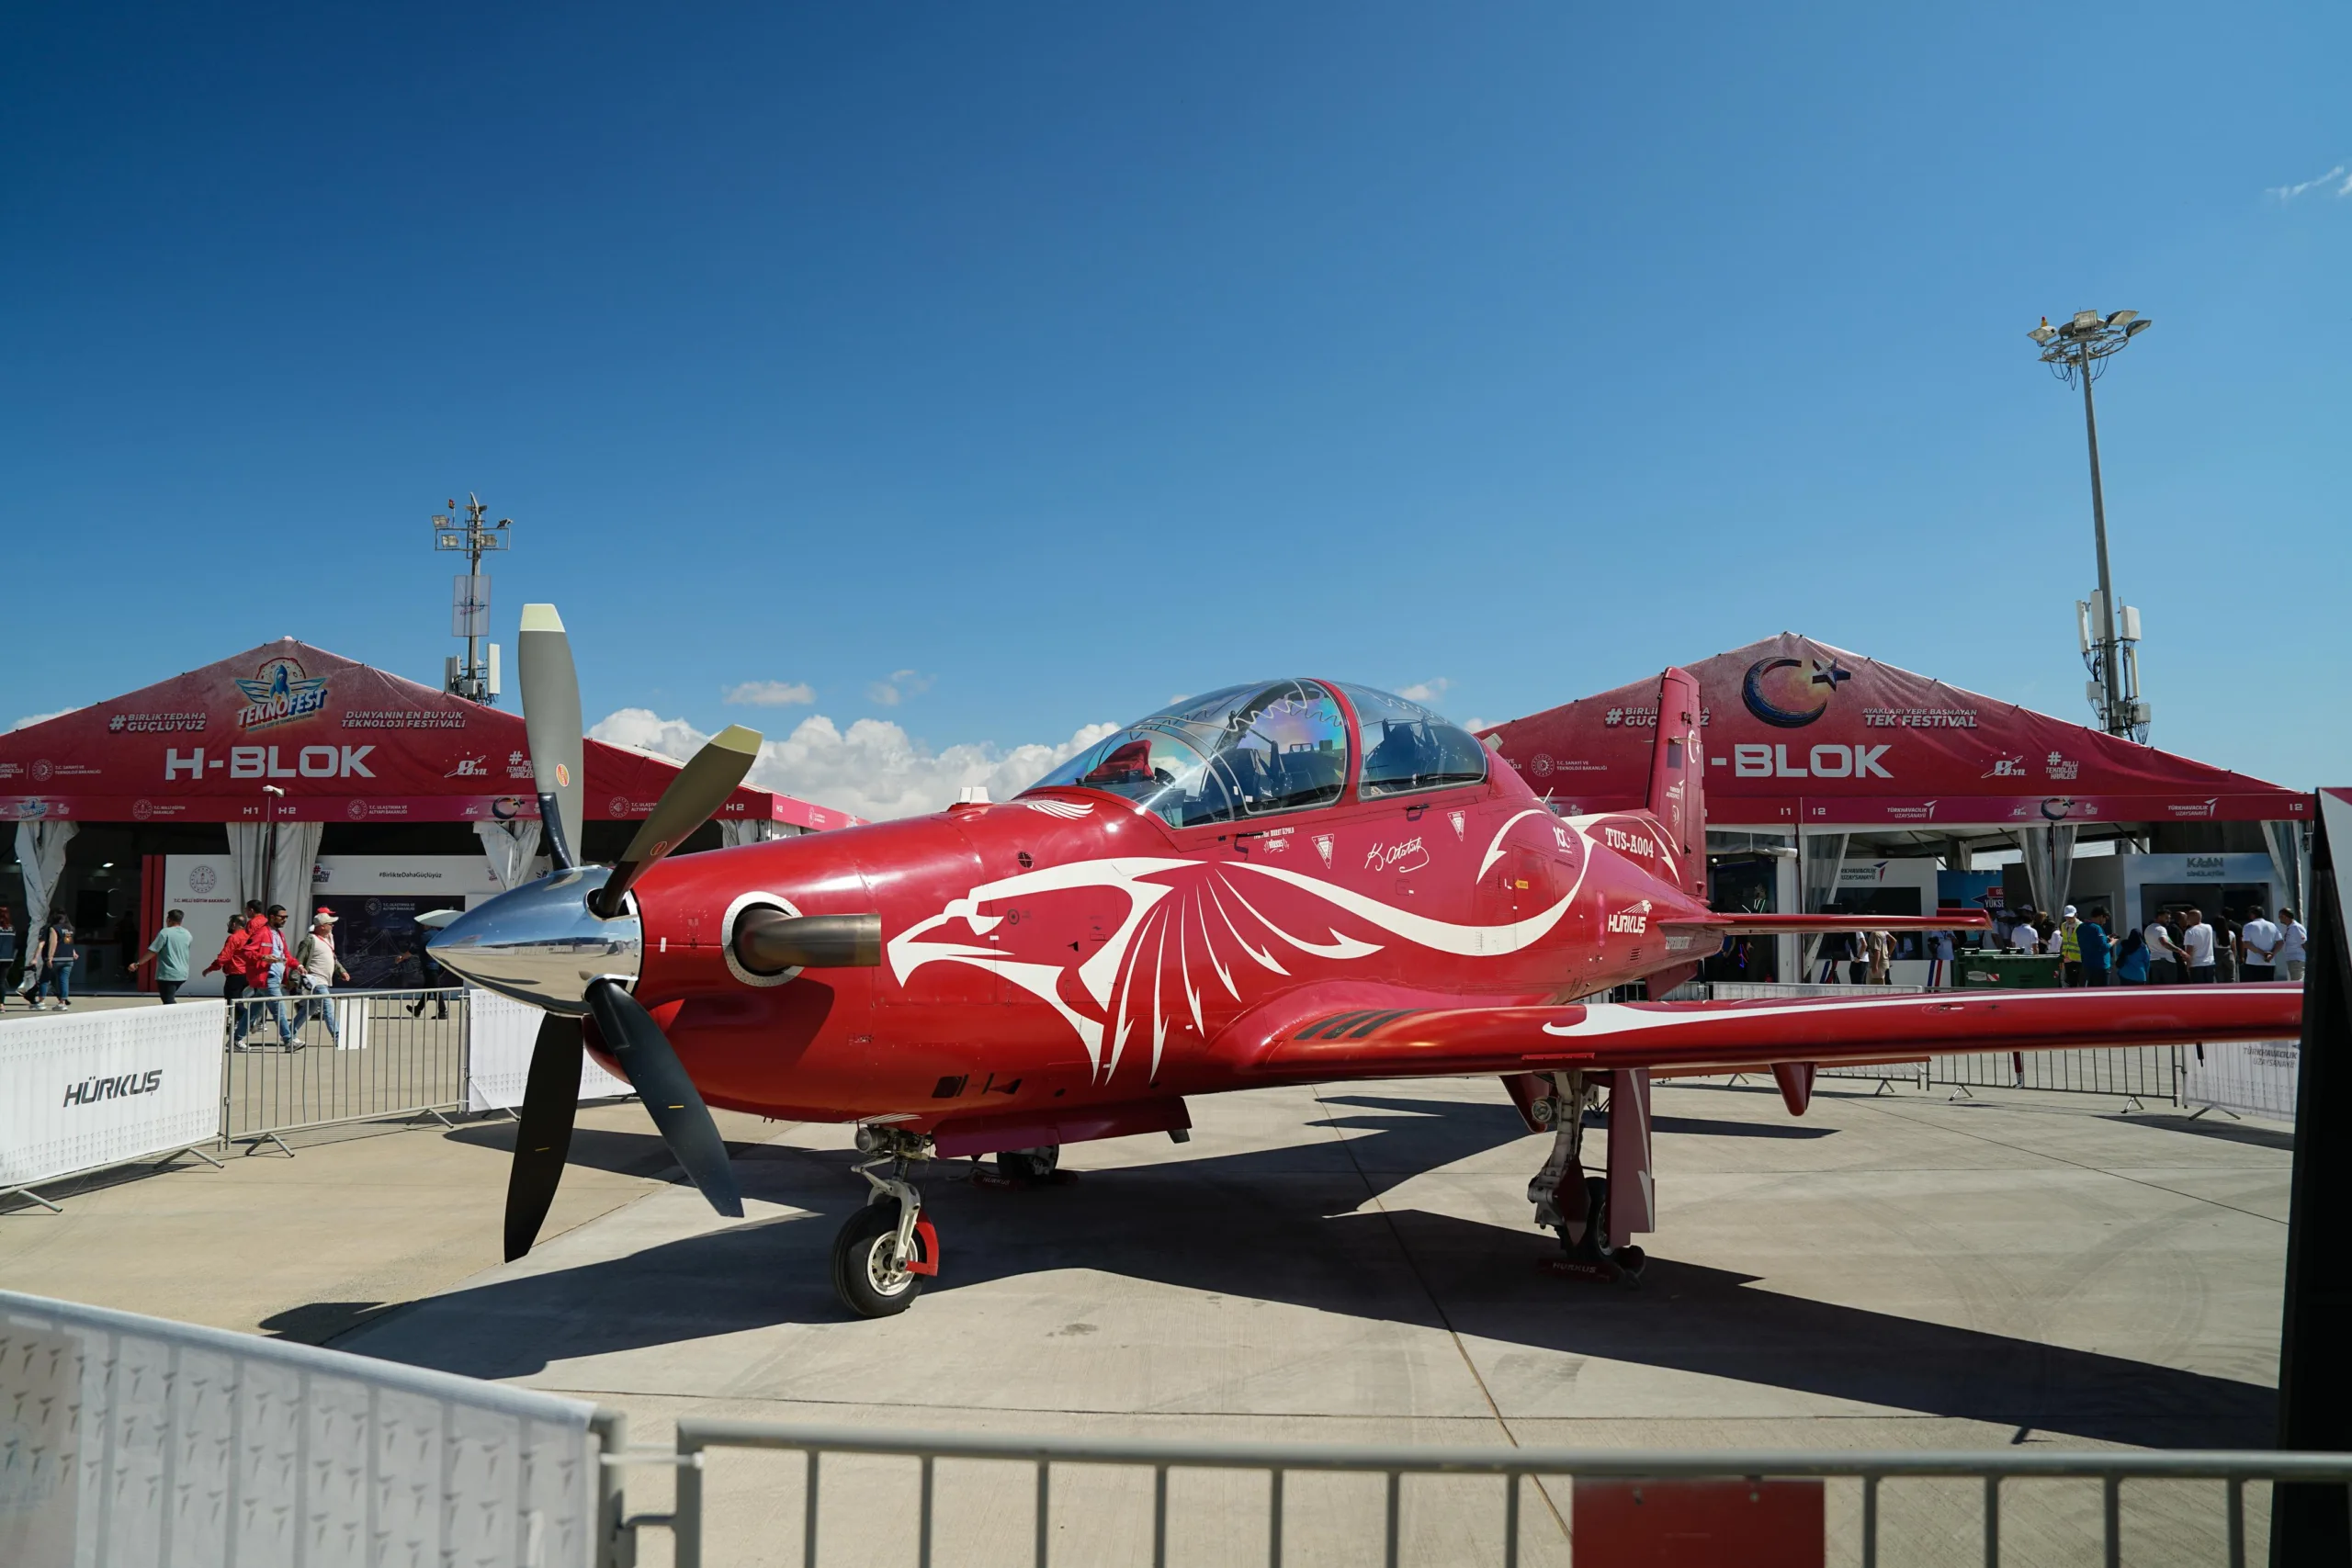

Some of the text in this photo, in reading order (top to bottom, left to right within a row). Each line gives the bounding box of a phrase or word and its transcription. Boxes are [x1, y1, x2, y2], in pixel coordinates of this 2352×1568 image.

[237, 689, 326, 727] TEKNOFEST
[346, 711, 464, 719] DÜNYANIN EN BÜYÜK
[342, 719, 404, 728] TEKNOLOJİ
[1865, 714, 1896, 726] TEK
[165, 746, 377, 781] H-BLOK
[243, 807, 259, 815] H1
[278, 807, 296, 815] H2
[1605, 828, 1655, 859] TUS-A004
[1608, 910, 1647, 937] HÜRKUŞ
[63, 1069, 163, 1108] HÜRKUŞ
